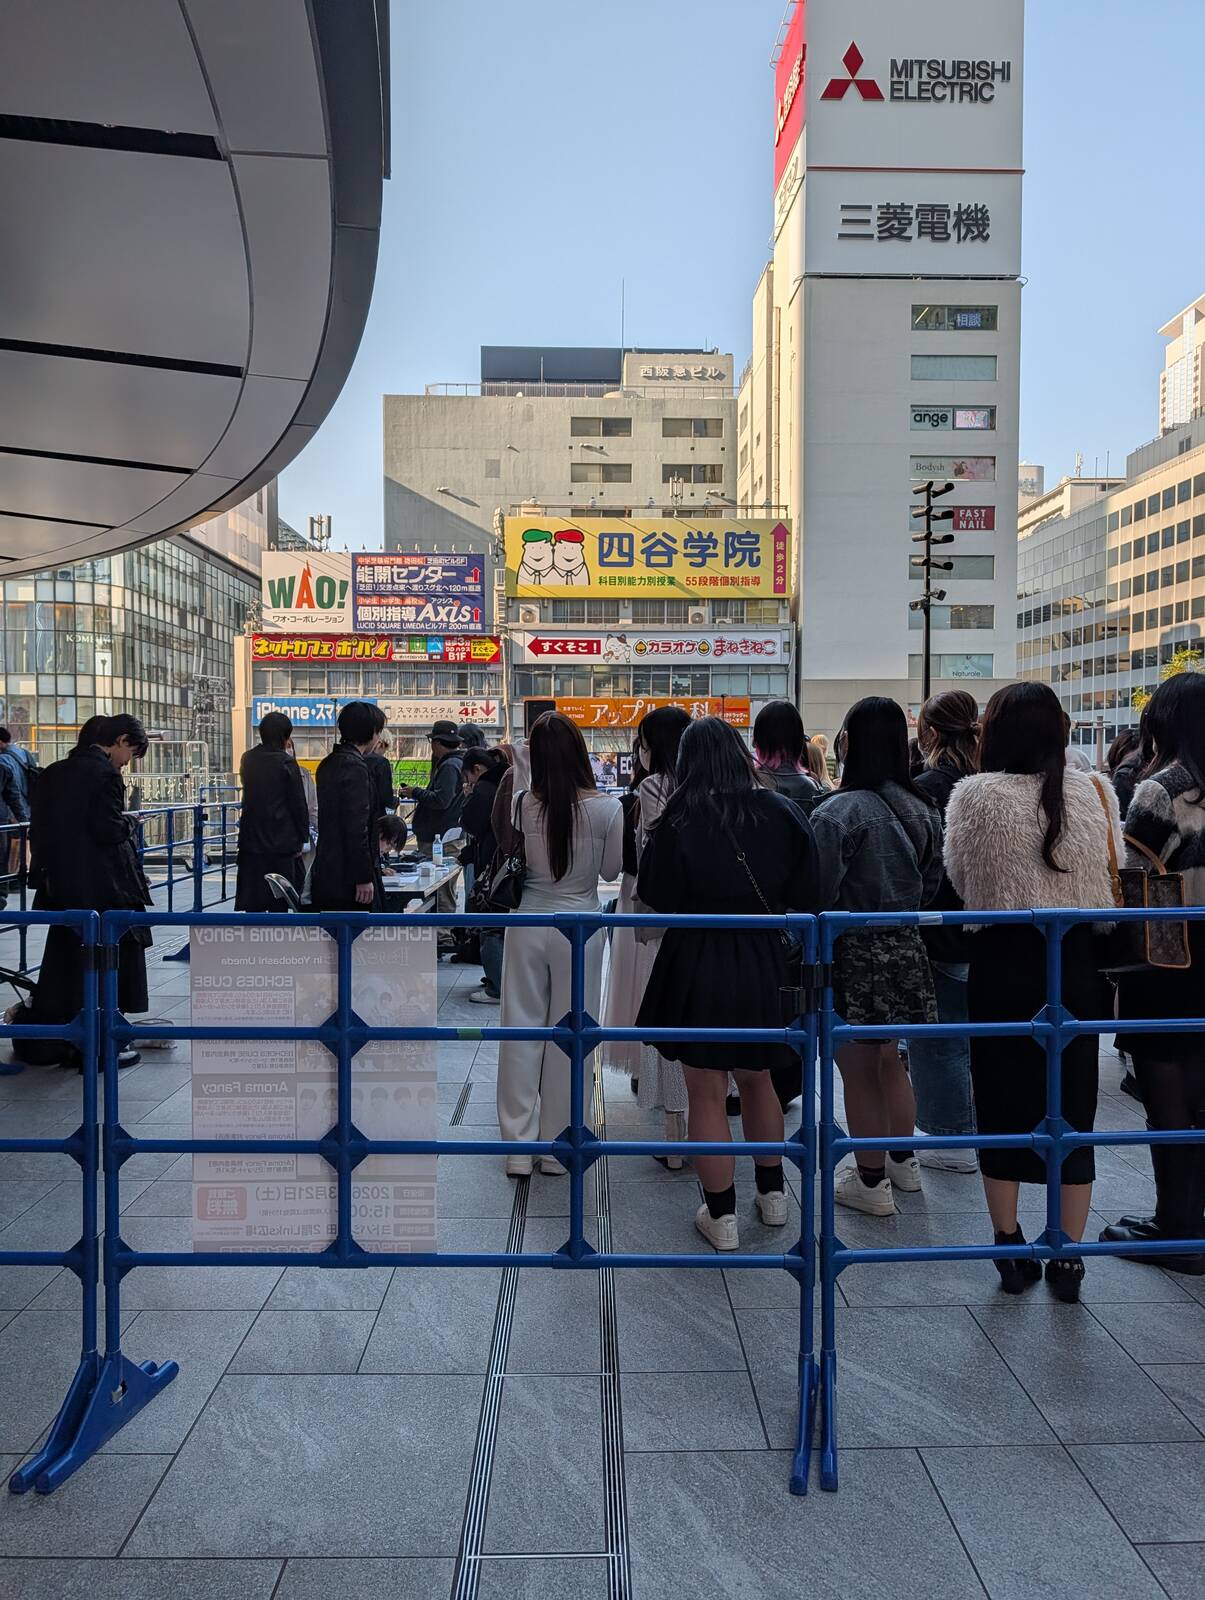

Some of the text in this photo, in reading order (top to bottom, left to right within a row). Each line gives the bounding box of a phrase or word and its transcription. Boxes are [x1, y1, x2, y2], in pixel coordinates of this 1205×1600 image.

[890, 59, 1011, 82] MITSUBISHI
[890, 82, 994, 103] ELECTRIC
[837, 203, 991, 243] 三菱電機
[914, 413, 948, 427] ange
[959, 509, 986, 517] FAST
[598, 531, 761, 568] 四谷学院
[775, 541, 785, 585] 徒歩2分
[356, 566, 457, 584] 能開センター
[598, 575, 761, 587] 科目別能力別授業 55段階個別指導
[268, 560, 349, 610] WAO!
[272, 615, 344, 624] ワオ・コーポレーション
[357, 606, 416, 621] 個別指導
[254, 639, 391, 658] ネットカフェ ポパイ
[648, 636, 777, 657] カラオケ まねきねこ
[448, 652, 466, 660] B1F
[458, 708, 478, 717] 4F
